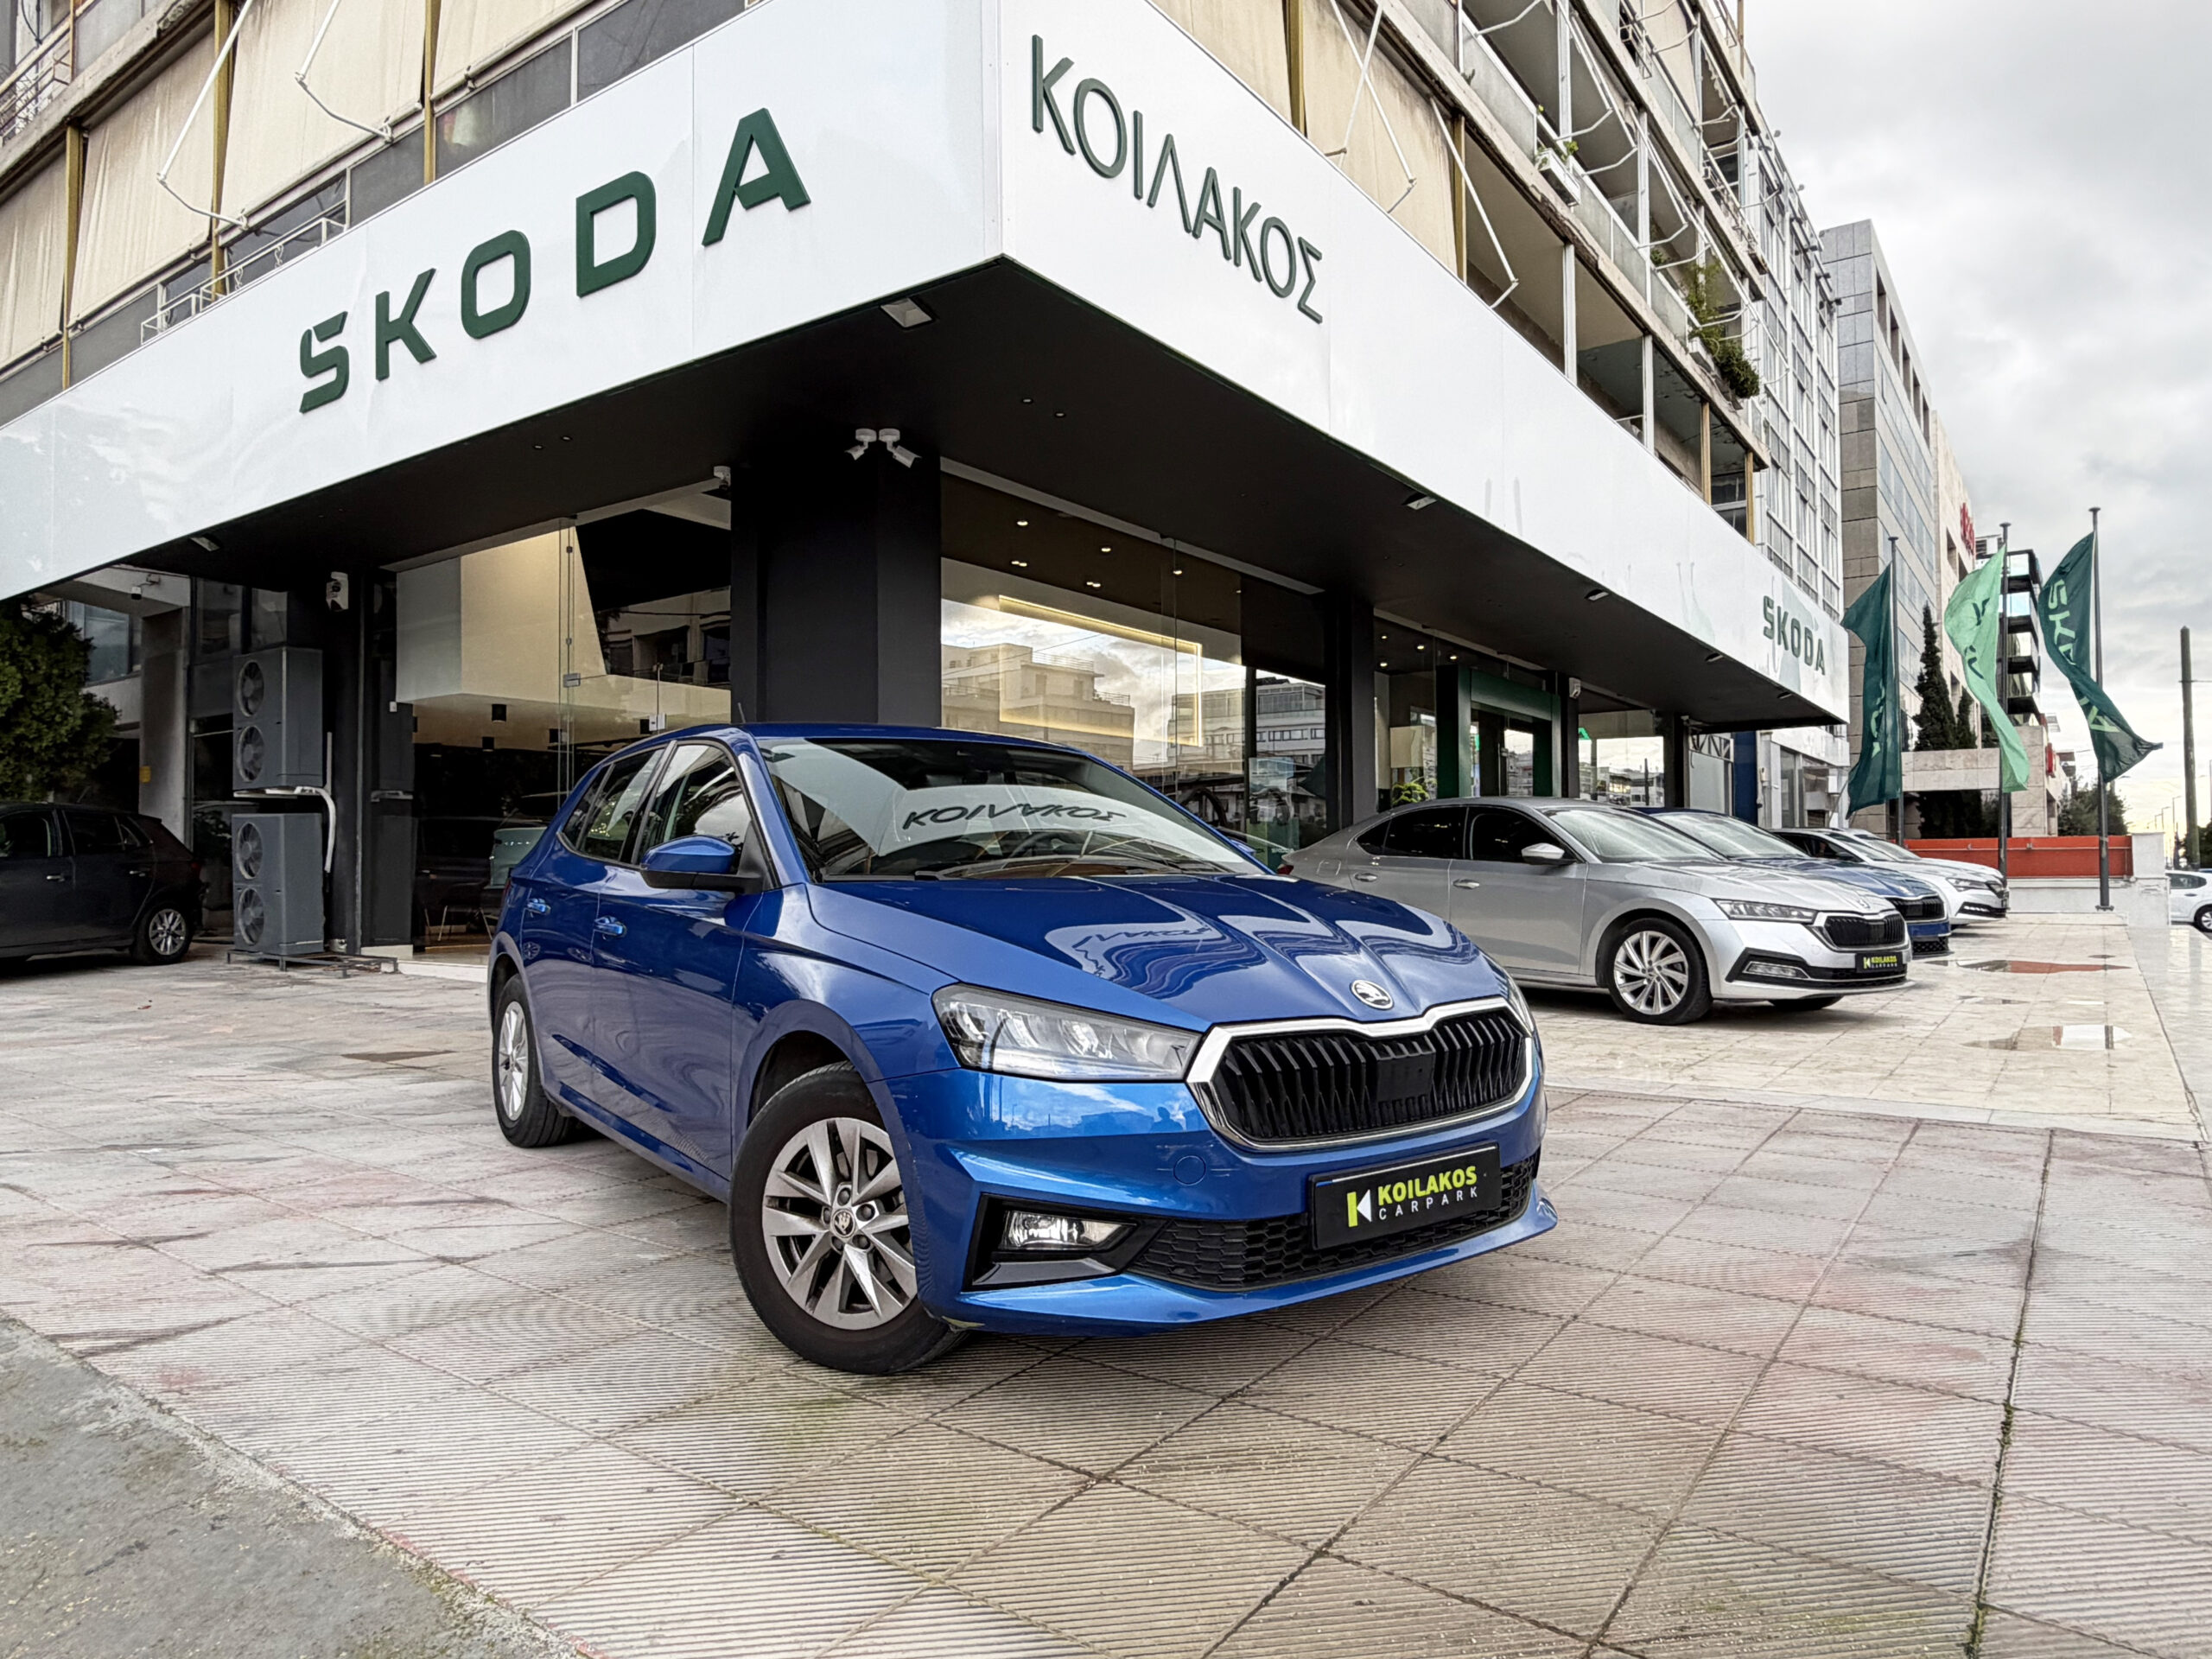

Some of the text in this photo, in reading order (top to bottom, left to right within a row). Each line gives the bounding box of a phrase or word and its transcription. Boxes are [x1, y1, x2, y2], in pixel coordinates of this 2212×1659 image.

[1032, 34, 1323, 325] ΚΟΙΛΑΚΟΣ
[299, 107, 811, 414] SKODA
[1763, 595, 1826, 676] SKODA
[1377, 1166, 1478, 1206] KOILAKOS
[1378, 1186, 1478, 1220] CARPARK
